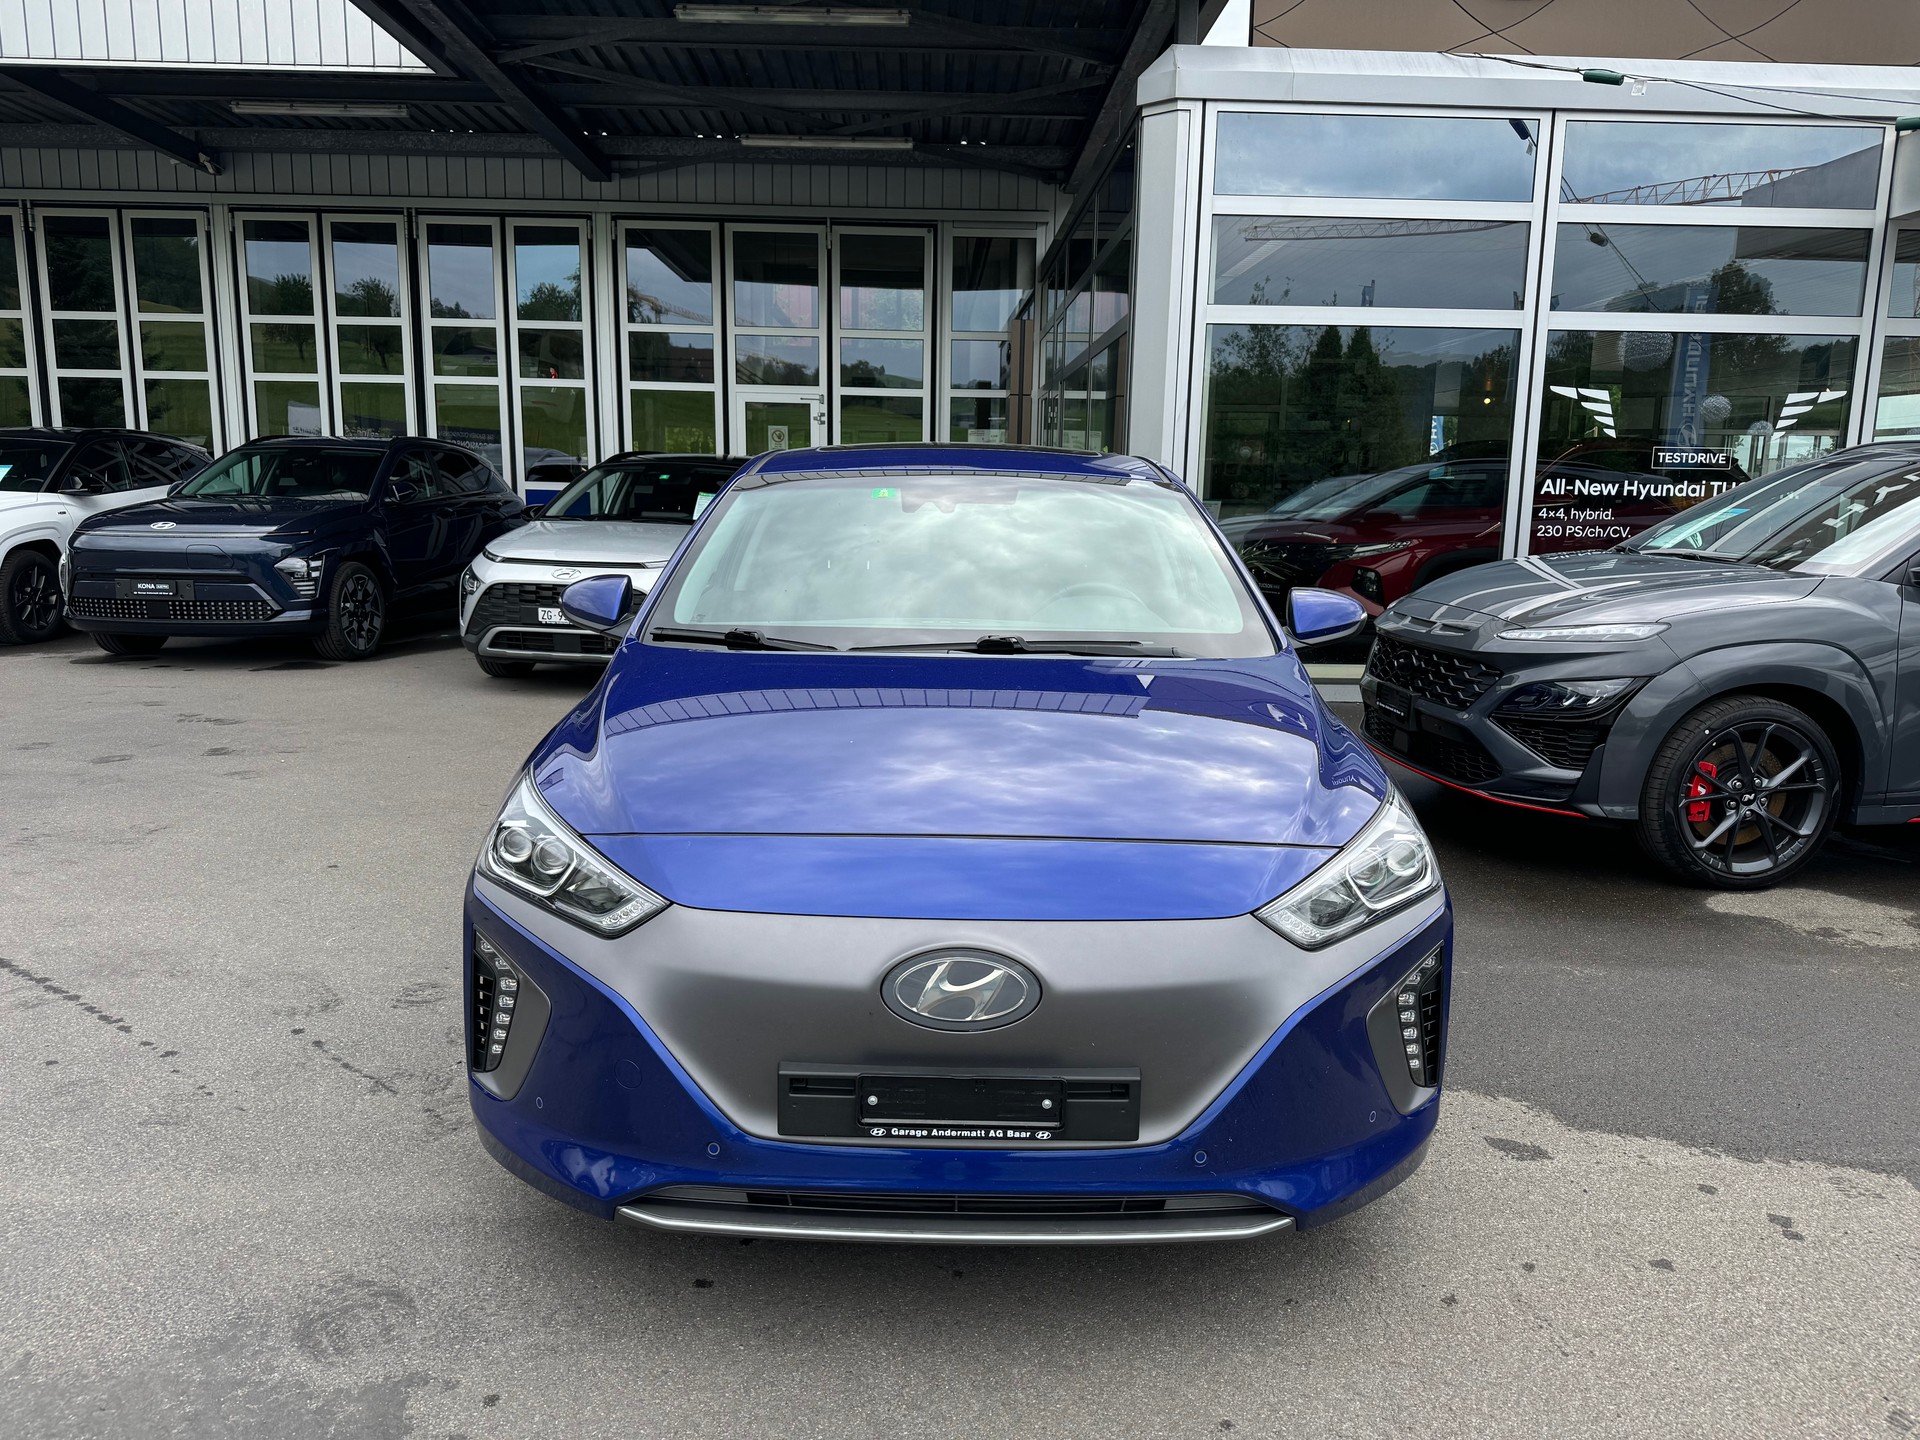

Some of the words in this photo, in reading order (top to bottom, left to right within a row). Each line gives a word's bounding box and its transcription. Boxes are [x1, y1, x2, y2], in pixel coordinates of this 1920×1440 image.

[1657, 452, 1727, 464] TESTDRIVE
[1540, 479, 1620, 496] All-New
[1623, 480, 1706, 500] Hyundai
[1570, 507, 1615, 523] hybrid.
[1536, 525, 1562, 537] 230
[1565, 526, 1632, 539] PS/ch/CV.
[891, 1128, 928, 1137] Garage
[931, 1128, 985, 1138] Andermatt
[988, 1129, 1004, 1138] AG
[1006, 1129, 1031, 1138] Baar
